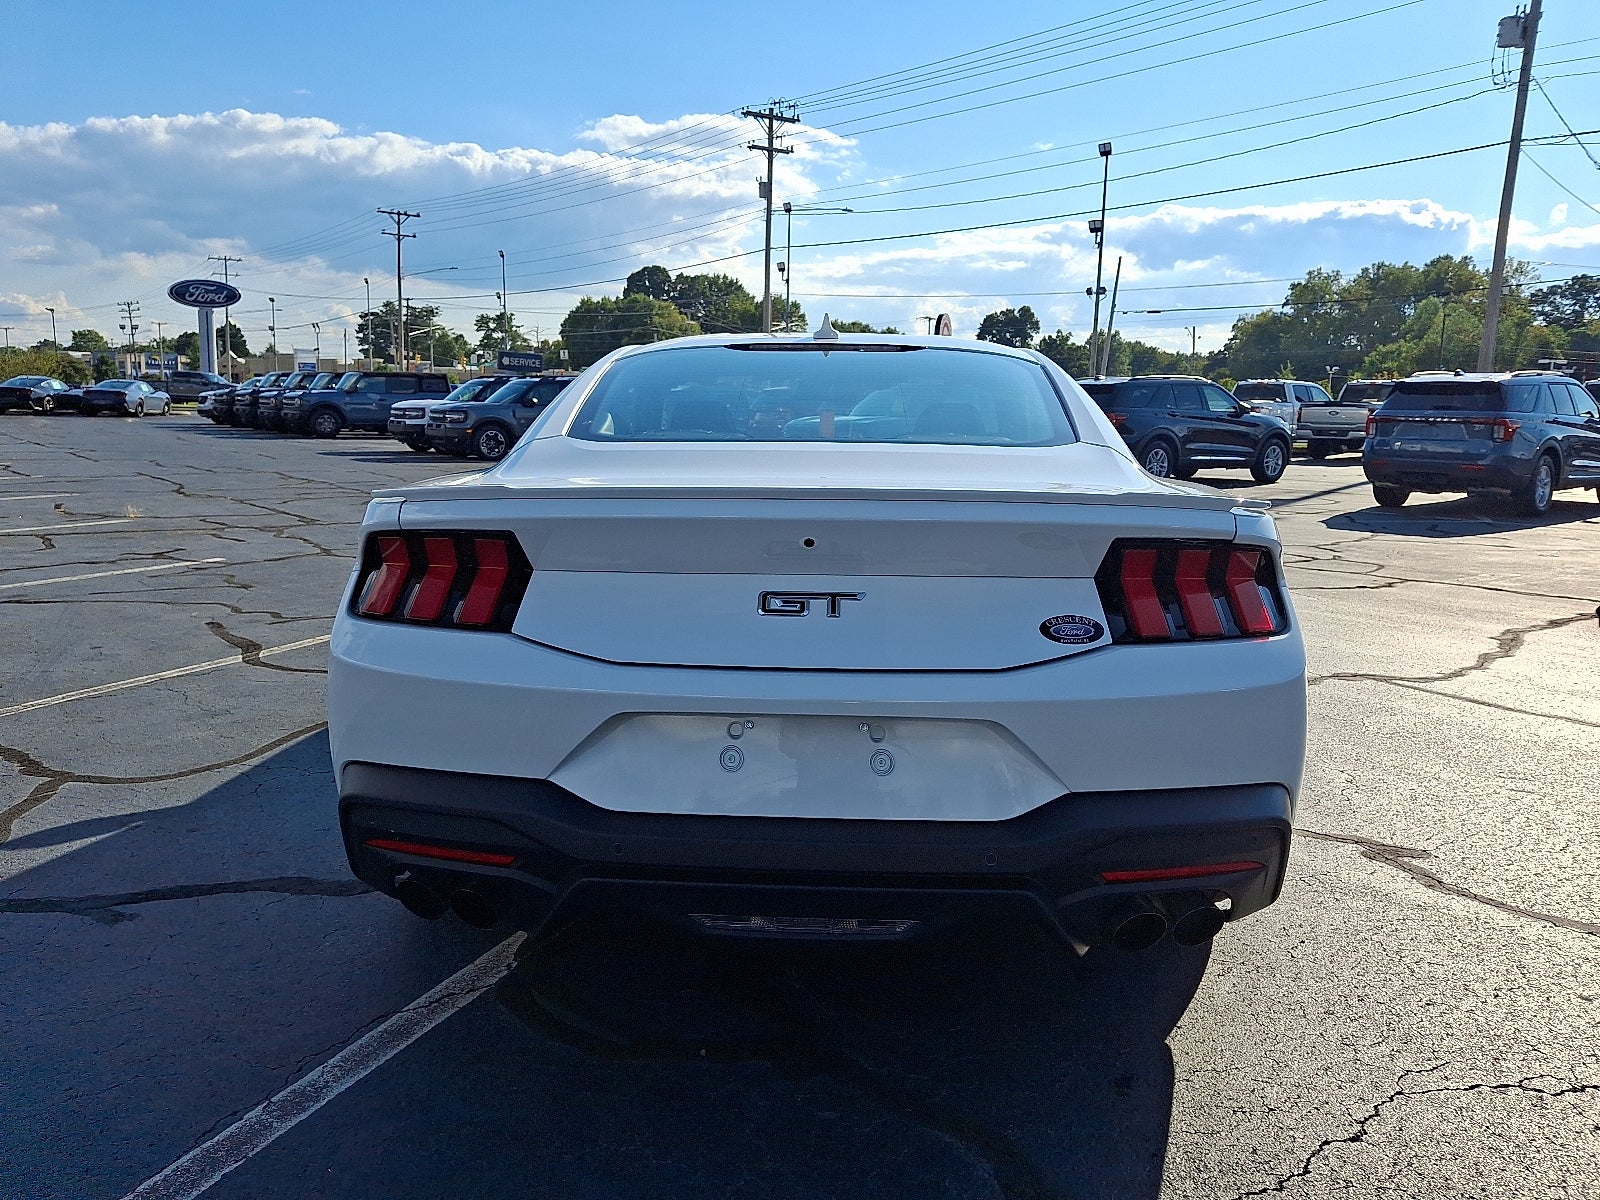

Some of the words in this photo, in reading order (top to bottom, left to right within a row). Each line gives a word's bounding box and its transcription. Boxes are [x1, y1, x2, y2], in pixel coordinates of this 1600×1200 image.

[185, 284, 227, 302] Ford
[510, 357, 541, 367] SERVICE
[757, 590, 867, 618] GT
[1045, 616, 1095, 626] CRESCENT
[1059, 625, 1085, 635] Ford
